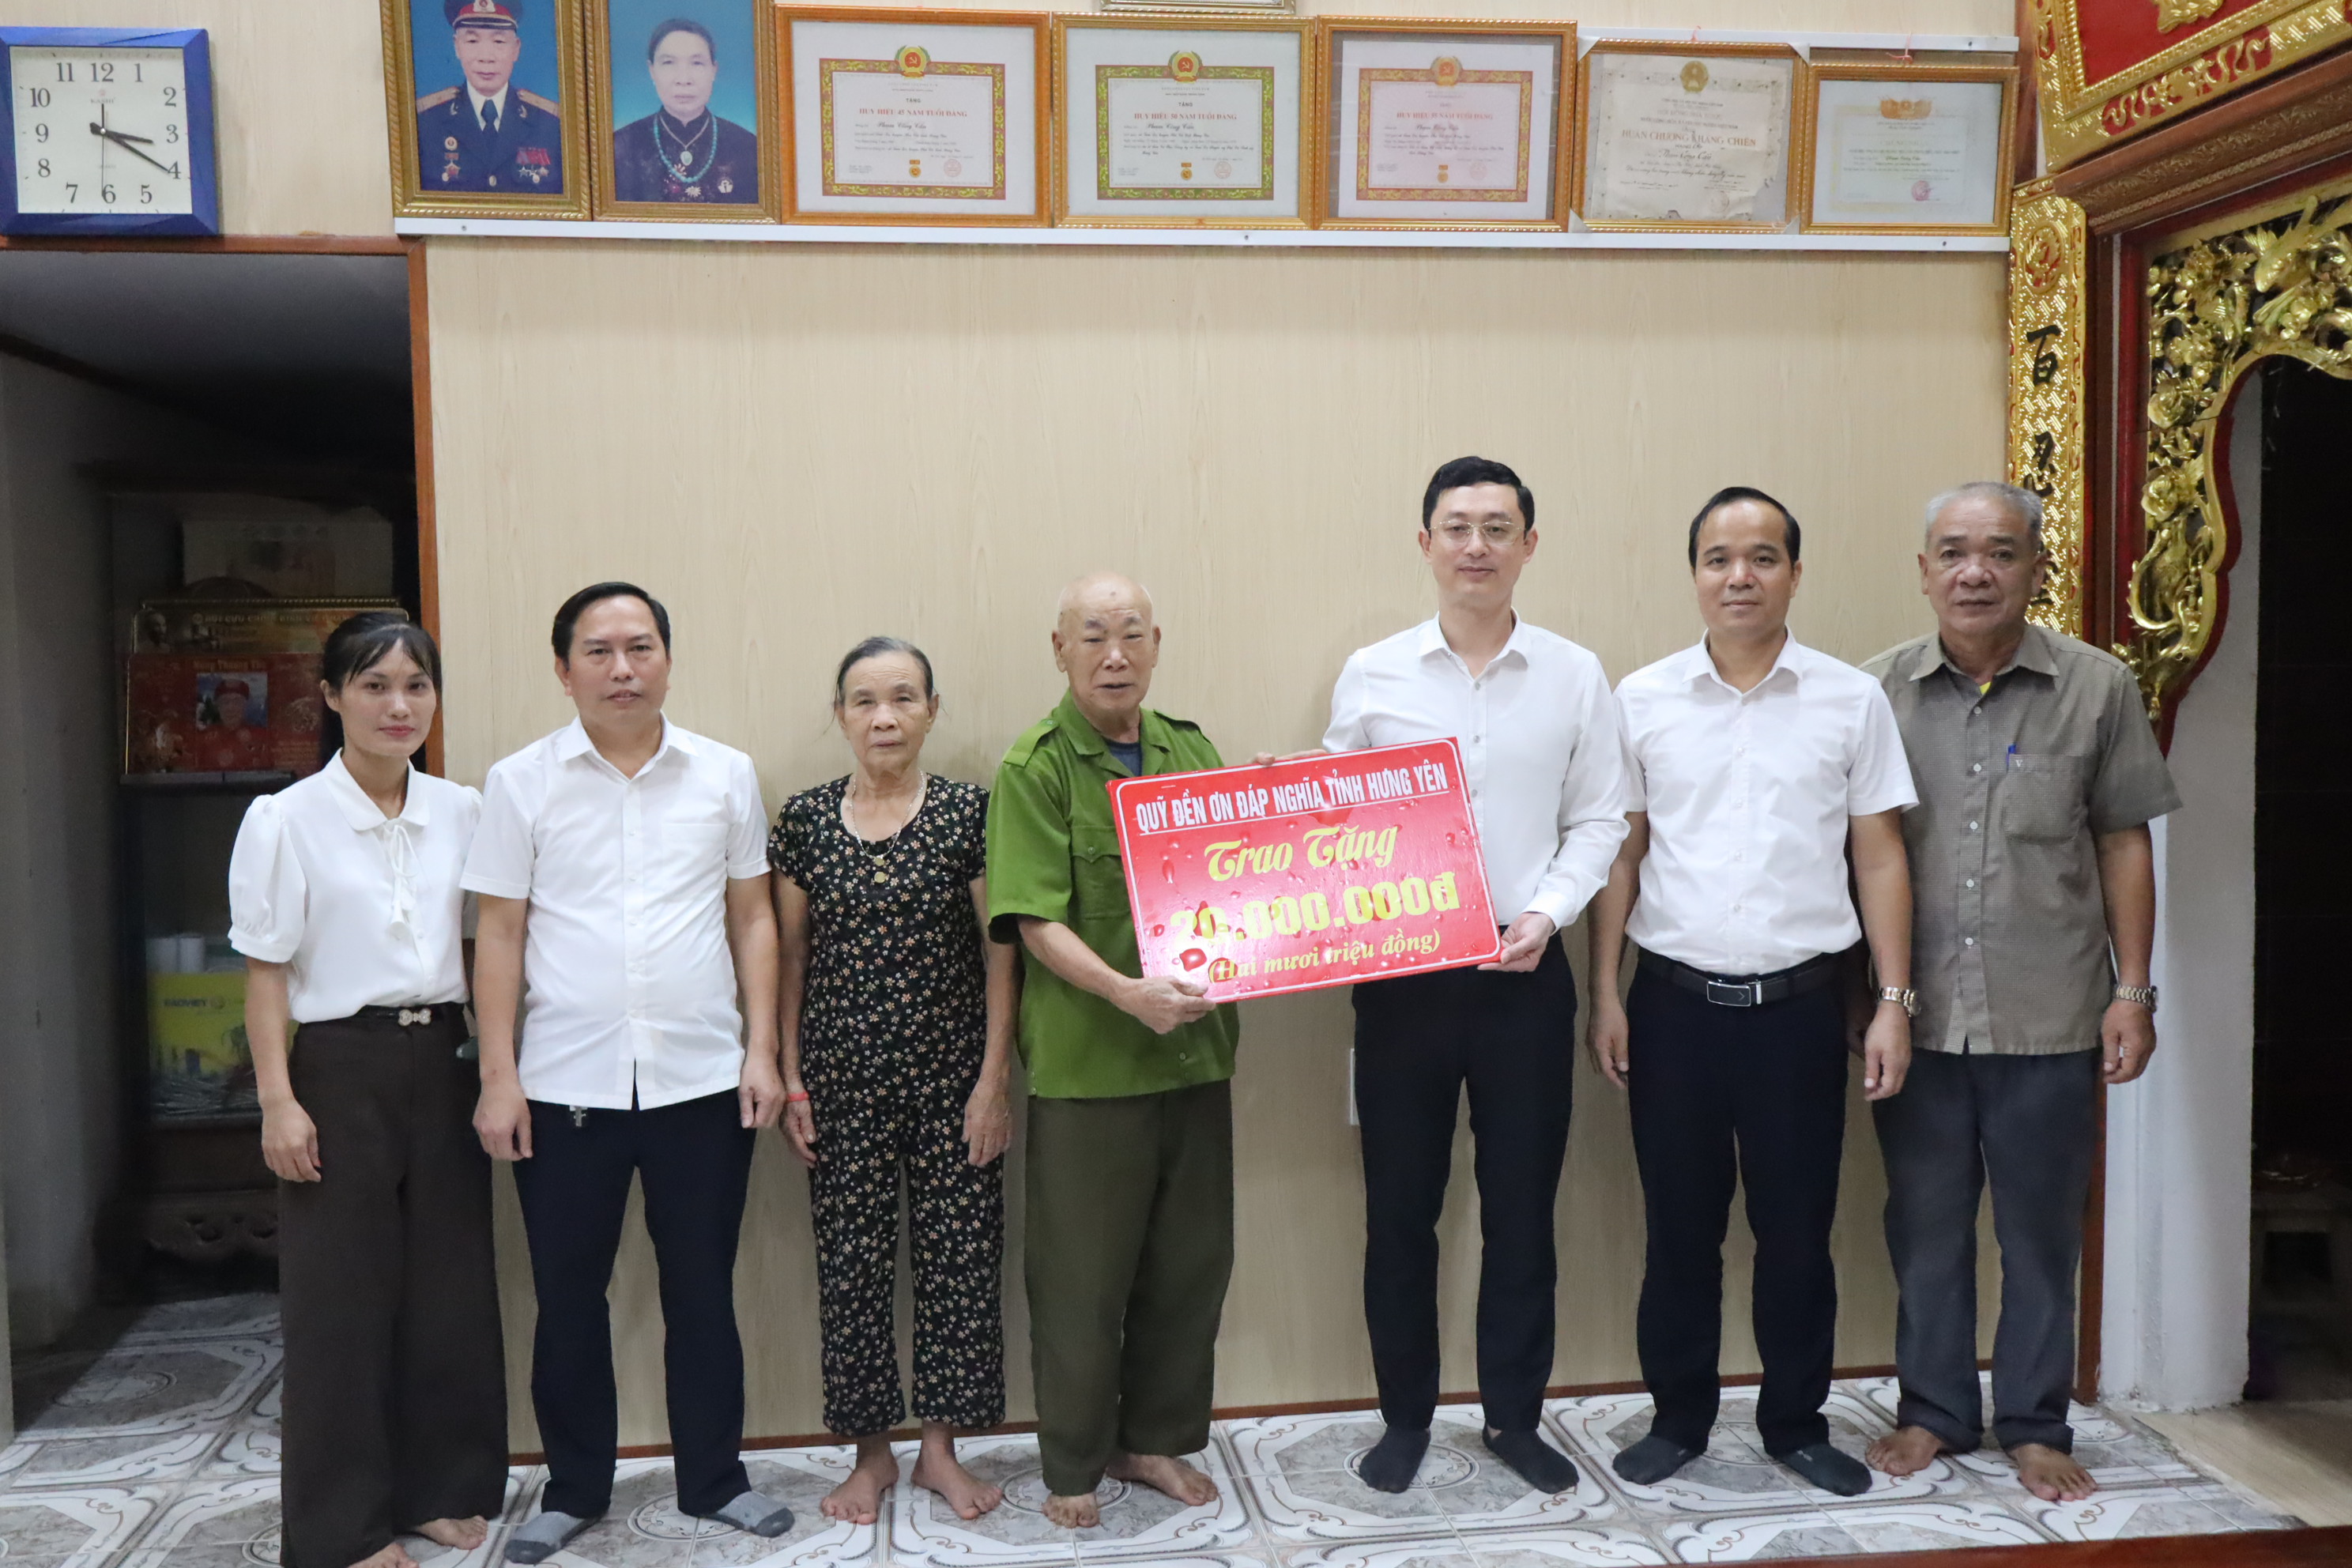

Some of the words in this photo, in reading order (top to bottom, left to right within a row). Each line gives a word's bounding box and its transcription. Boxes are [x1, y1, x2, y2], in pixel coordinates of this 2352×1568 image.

[56, 62, 75, 82] 11
[91, 62, 115, 82] 12
[134, 63, 143, 82] 1
[30, 88, 51, 107] 10
[163, 87, 177, 107] 2
[36, 123, 49, 143] 9
[166, 125, 179, 144] 3
[38, 159, 51, 178] 8
[168, 160, 181, 179] 4
[66, 182, 78, 204] 7
[102, 184, 116, 204] 6
[140, 184, 153, 204] 5
[1136, 796, 1169, 833] QUỸ
[1171, 789, 1208, 827] ĐỀN
[1209, 791, 1234, 822] ƠN
[1235, 784, 1269, 818] ĐÁP
[1272, 776, 1325, 813] NGHĨA
[1325, 769, 1366, 806] TỈNH
[1366, 767, 1413, 801] HƯNG
[1413, 759, 1449, 793] YÊN
[1204, 839, 1294, 882] Trao
[1302, 824, 1398, 871] Tặng
[1208, 955, 1257, 984] (Hai
[1265, 947, 1320, 974] mươi
[1324, 940, 1375, 966] triệu
[1381, 928, 1441, 955] đồng)
